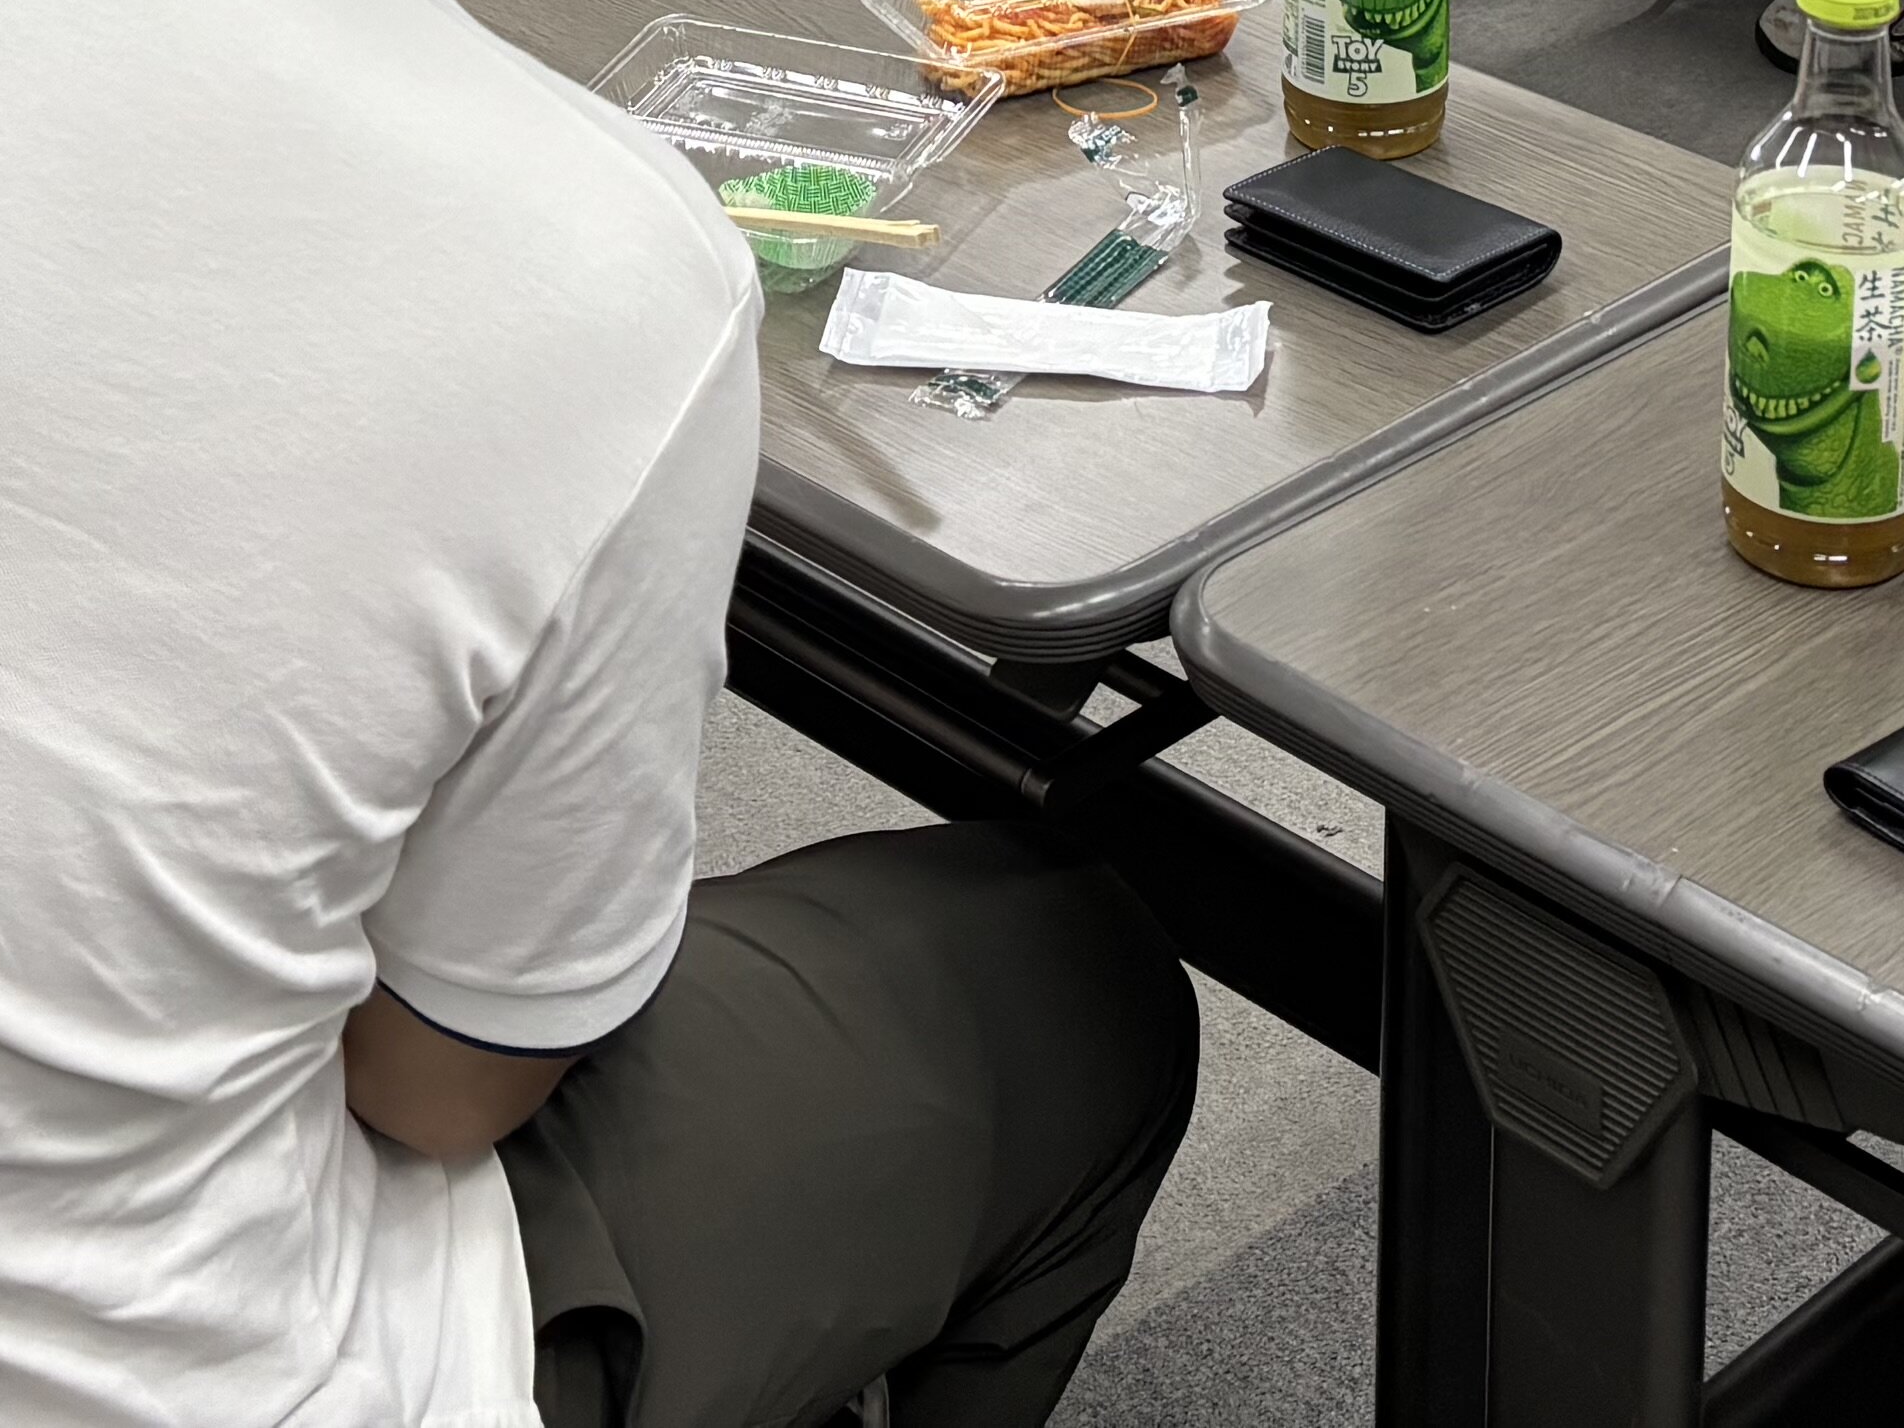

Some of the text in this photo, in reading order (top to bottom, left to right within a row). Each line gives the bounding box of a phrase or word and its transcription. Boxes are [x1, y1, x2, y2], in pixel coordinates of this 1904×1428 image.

[1331, 34, 1385, 61] TOY
[1347, 72, 1369, 97] 5
[1856, 270, 1893, 342] 生茶
